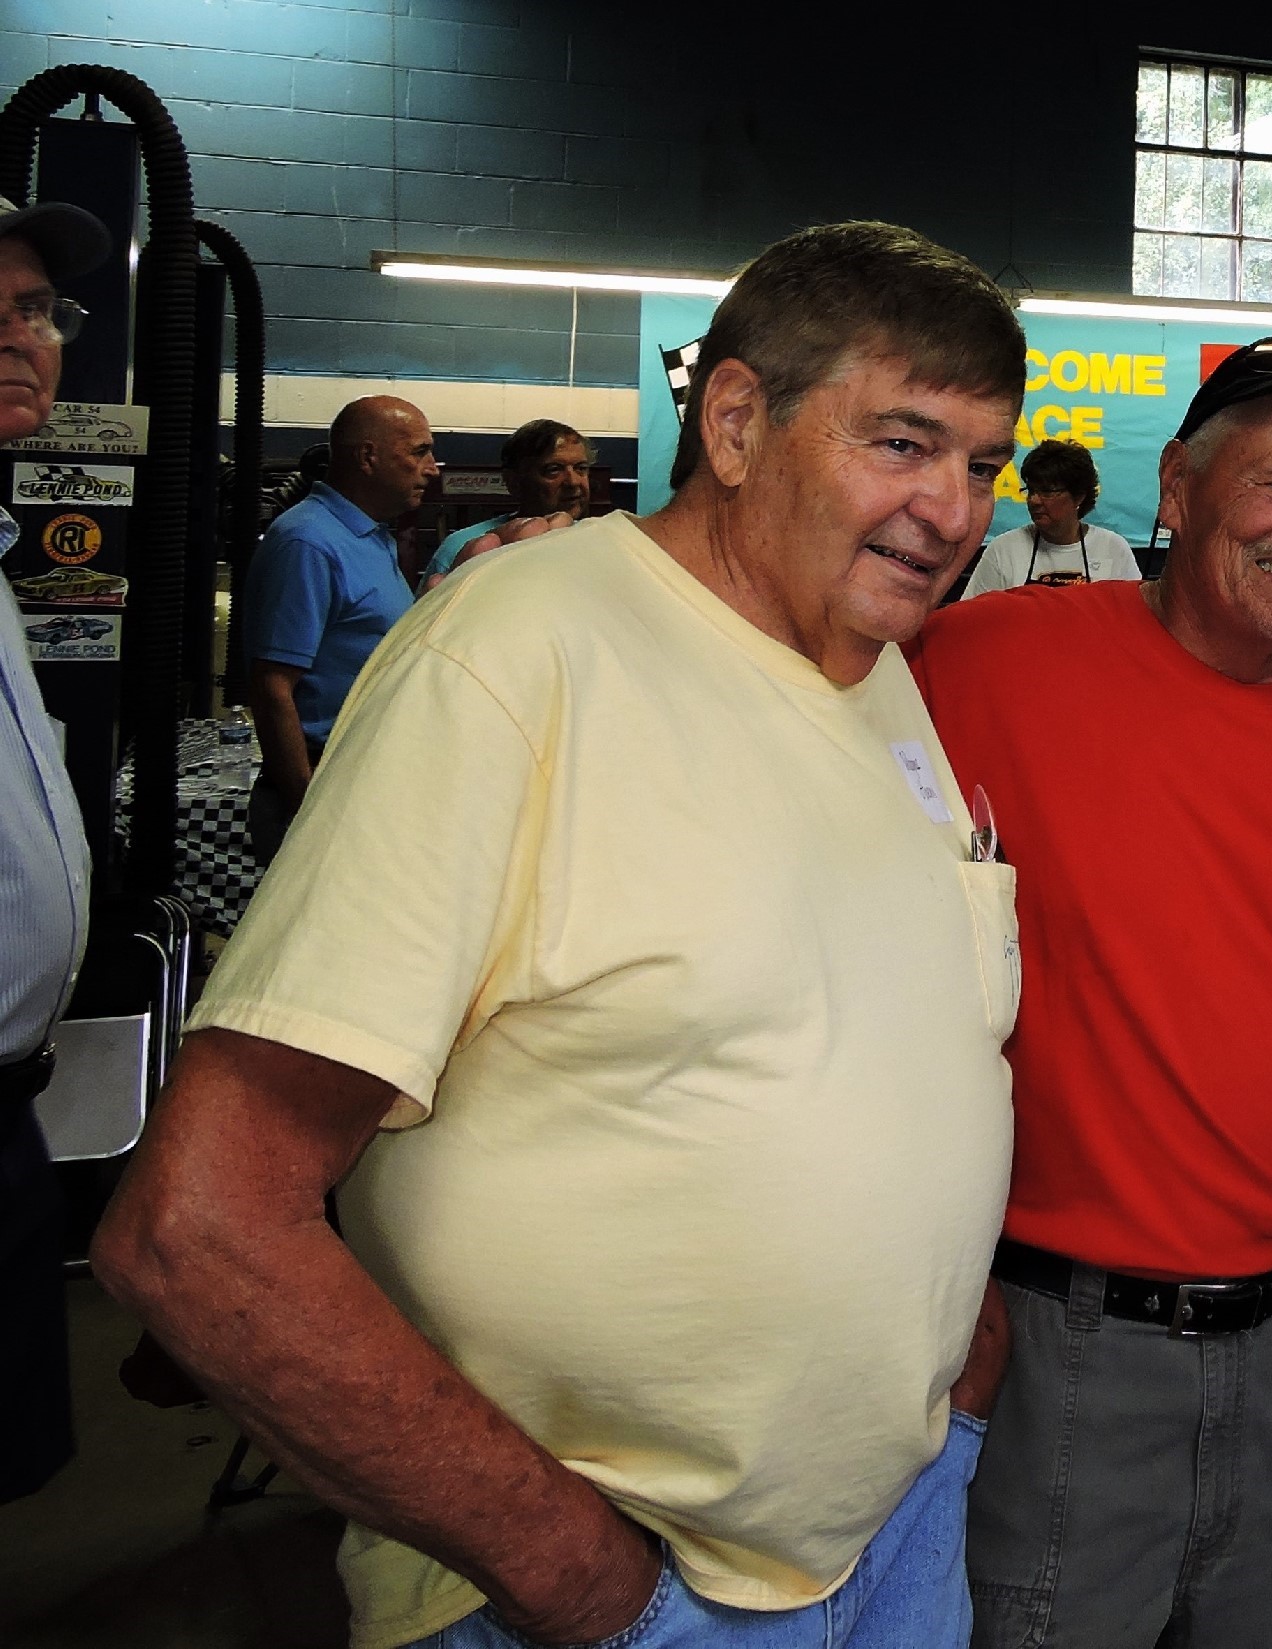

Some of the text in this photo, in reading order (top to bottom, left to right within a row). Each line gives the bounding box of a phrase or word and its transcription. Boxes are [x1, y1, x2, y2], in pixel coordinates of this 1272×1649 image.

[53, 403, 82, 414] CAR
[10, 439, 139, 454] WHERE ARE YOU?
[29, 482, 123, 495] LENNIE POND
